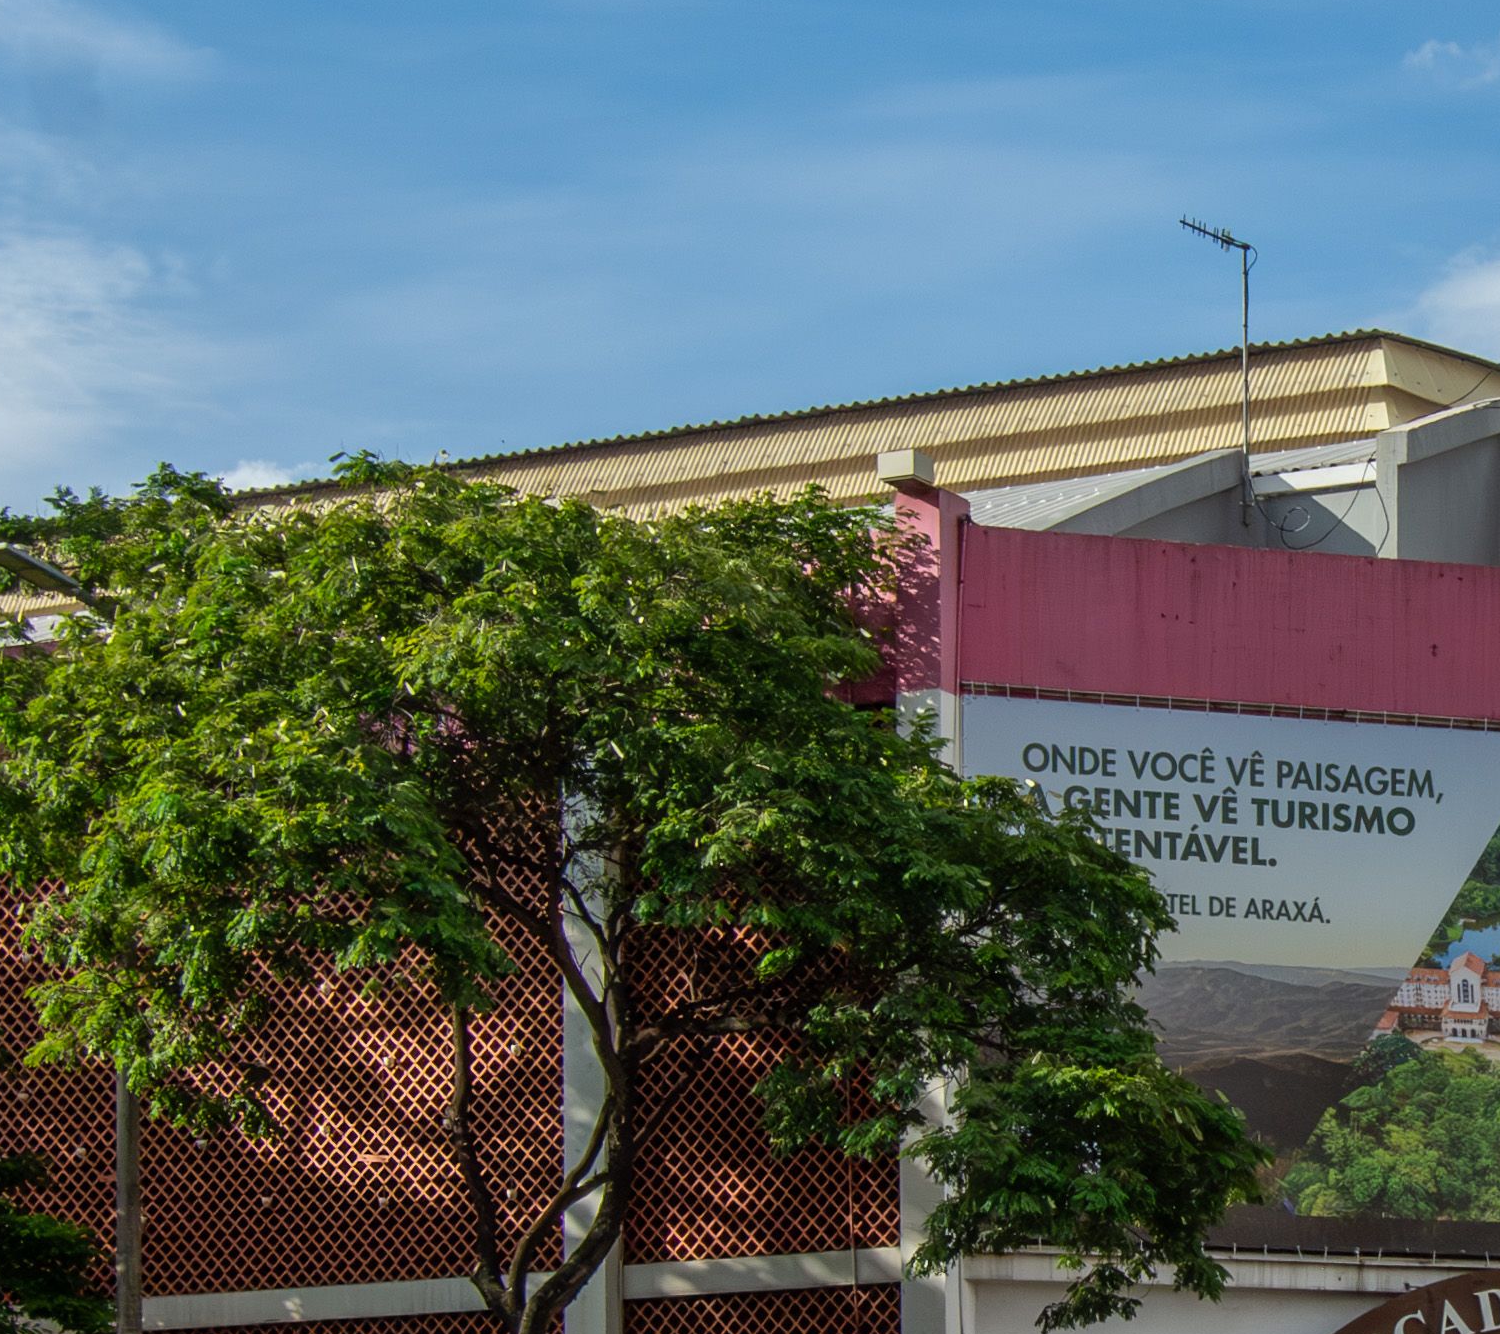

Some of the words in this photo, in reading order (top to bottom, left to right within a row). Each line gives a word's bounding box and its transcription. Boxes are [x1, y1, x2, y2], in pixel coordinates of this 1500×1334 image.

[1022, 742, 1116, 777] ONDE
[1127, 747, 1215, 783] VOCÊ
[1226, 750, 1264, 787] VÊ
[1276, 760, 1444, 805] PAISAGEM,
[1063, 785, 1180, 821] GENTE
[1193, 786, 1238, 825] VÊ
[1251, 798, 1415, 836] TURISMO
[1082, 824, 1278, 867] TENTÁVEL.
[1209, 895, 1237, 918] DE
[1243, 897, 1331, 924] ARAXÁ.
